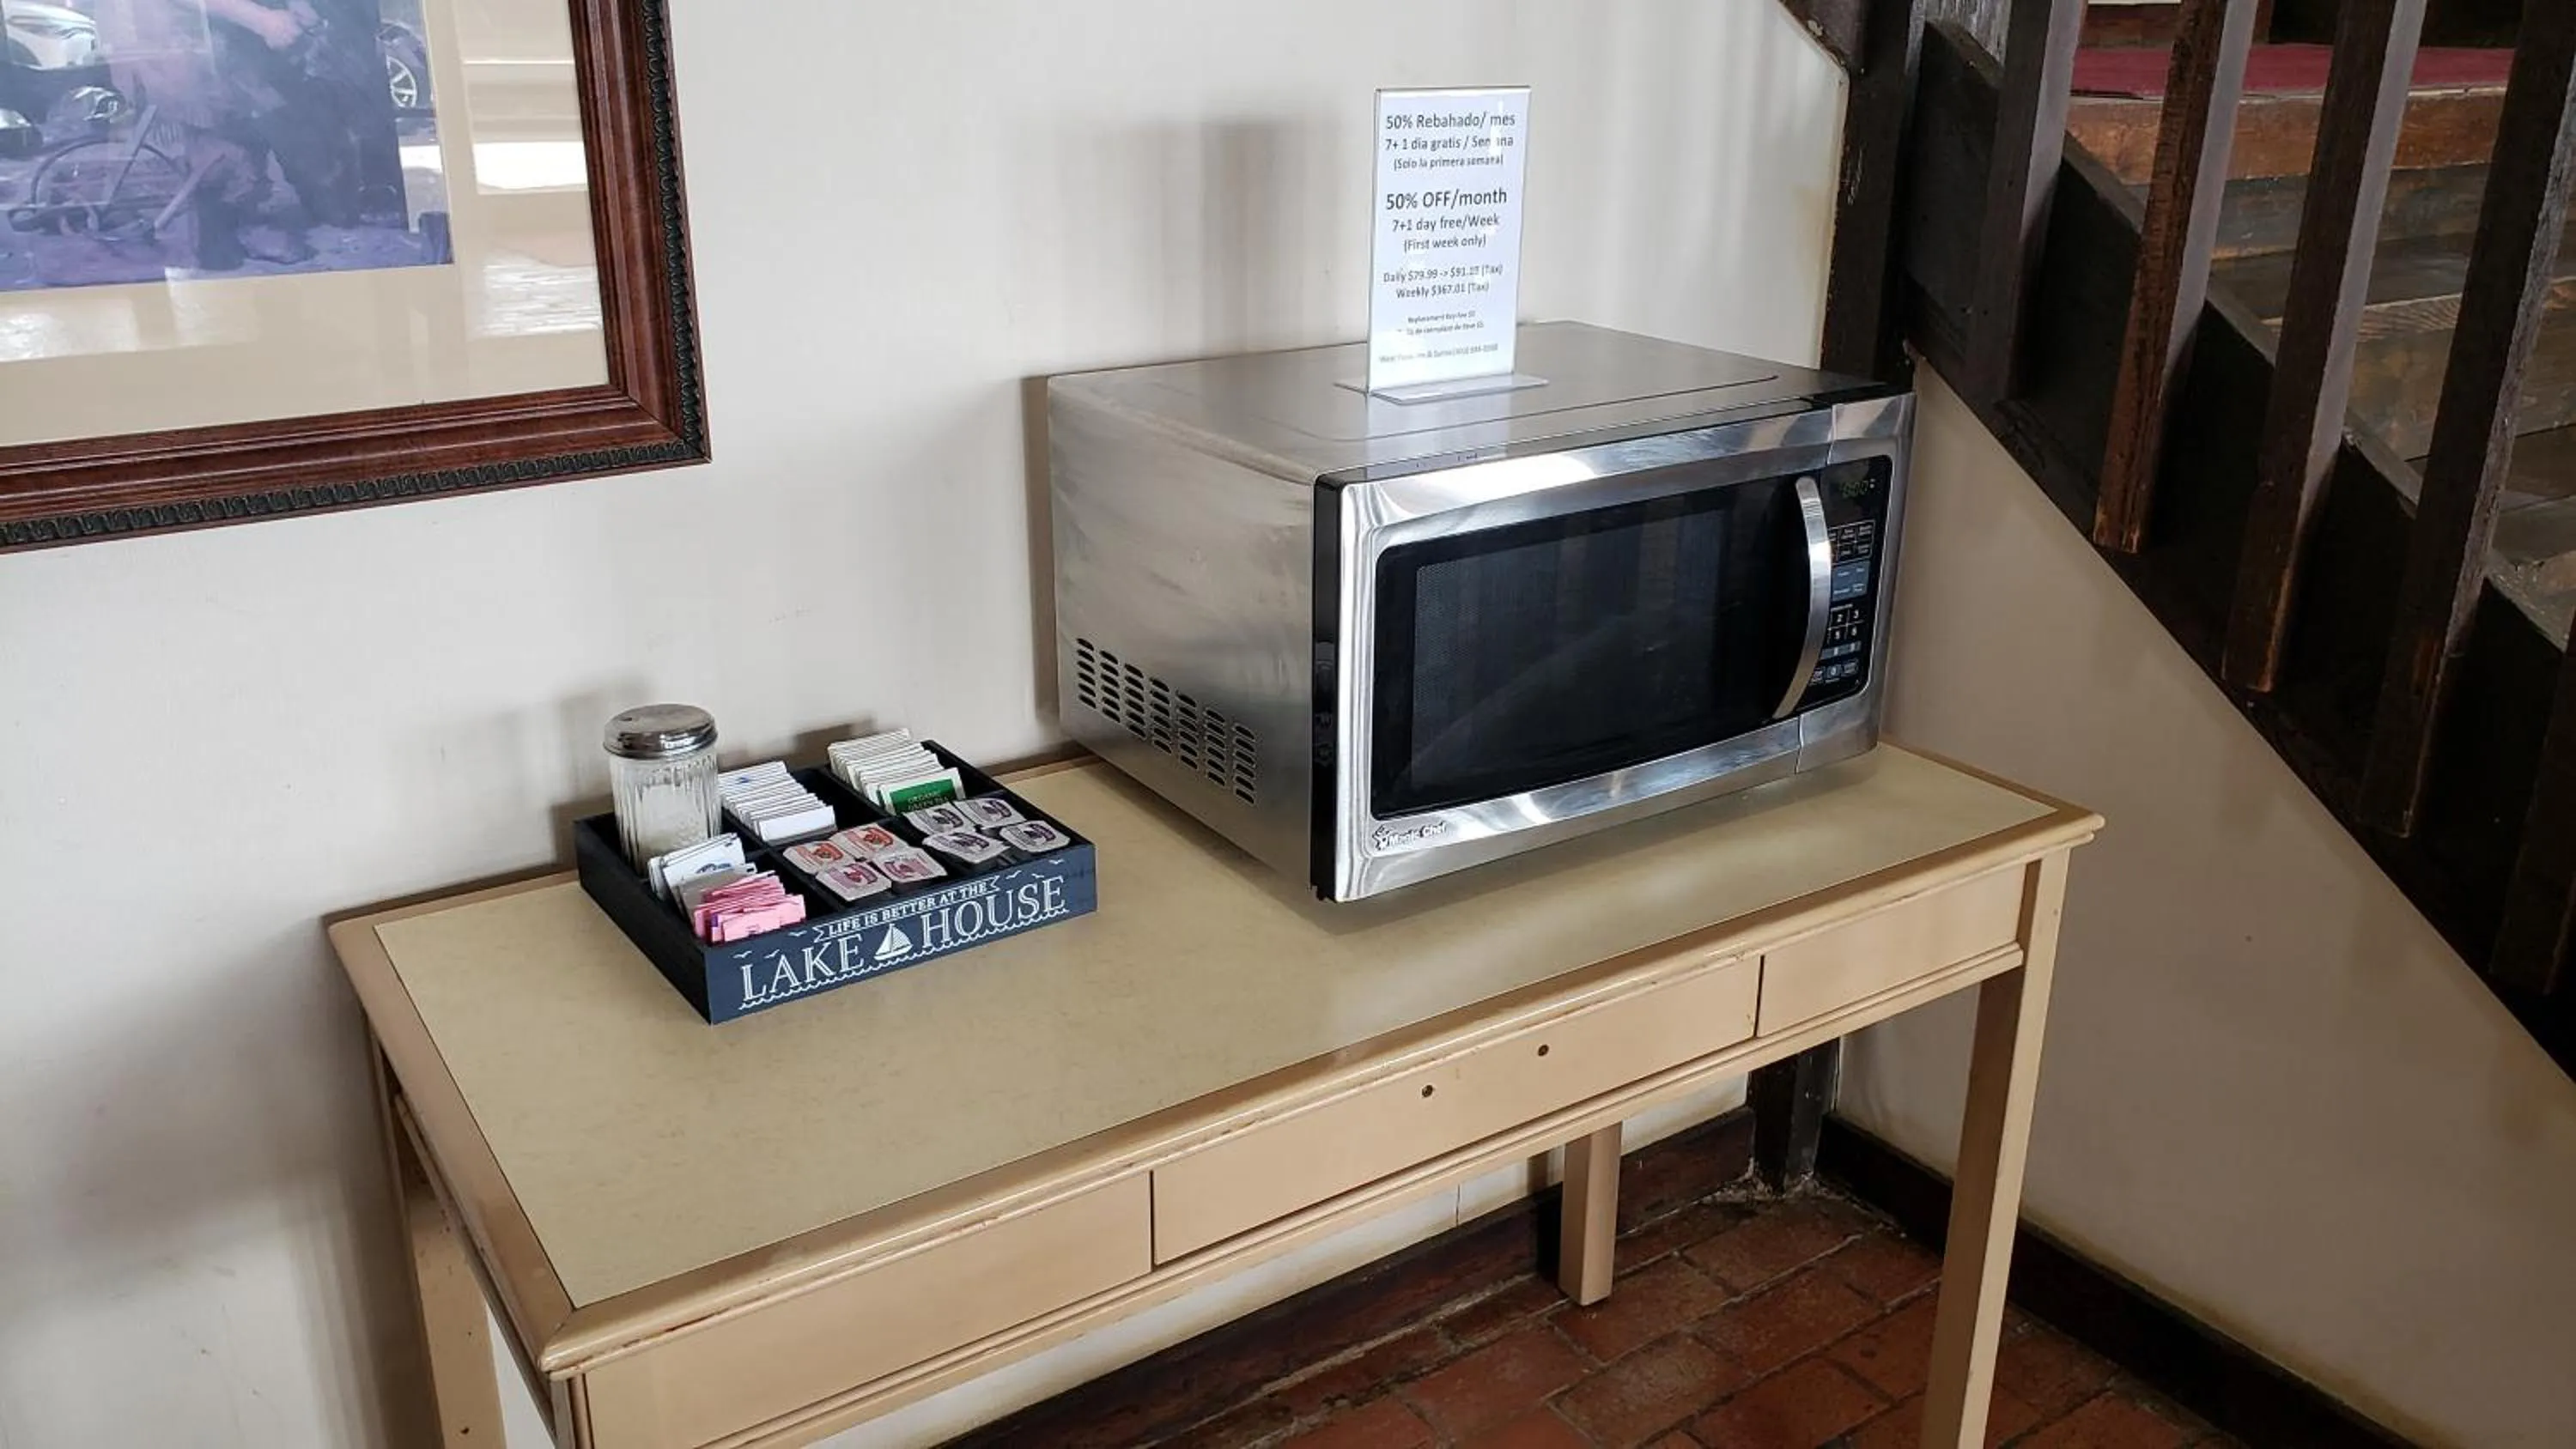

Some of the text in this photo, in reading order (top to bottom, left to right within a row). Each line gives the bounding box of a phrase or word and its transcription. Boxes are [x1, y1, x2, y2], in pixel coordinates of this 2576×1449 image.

[1385, 113, 1413, 130] 50%
[1490, 113, 1516, 126] mes
[1431, 136, 1461, 152] gratis
[1430, 156, 1465, 170] primera
[1385, 187, 1507, 210] 50% OFF/month
[1392, 213, 1500, 233] 7+1 day free/Week
[1404, 233, 1486, 254] (First week only)
[1383, 271, 1406, 283] Daily
[1395, 286, 1430, 299] Weekly
[1421, 820, 1448, 838] Chef
[829, 882, 989, 936] LIFE IS BETTER AT THE
[740, 876, 1067, 1003] LAKE HOUSE
